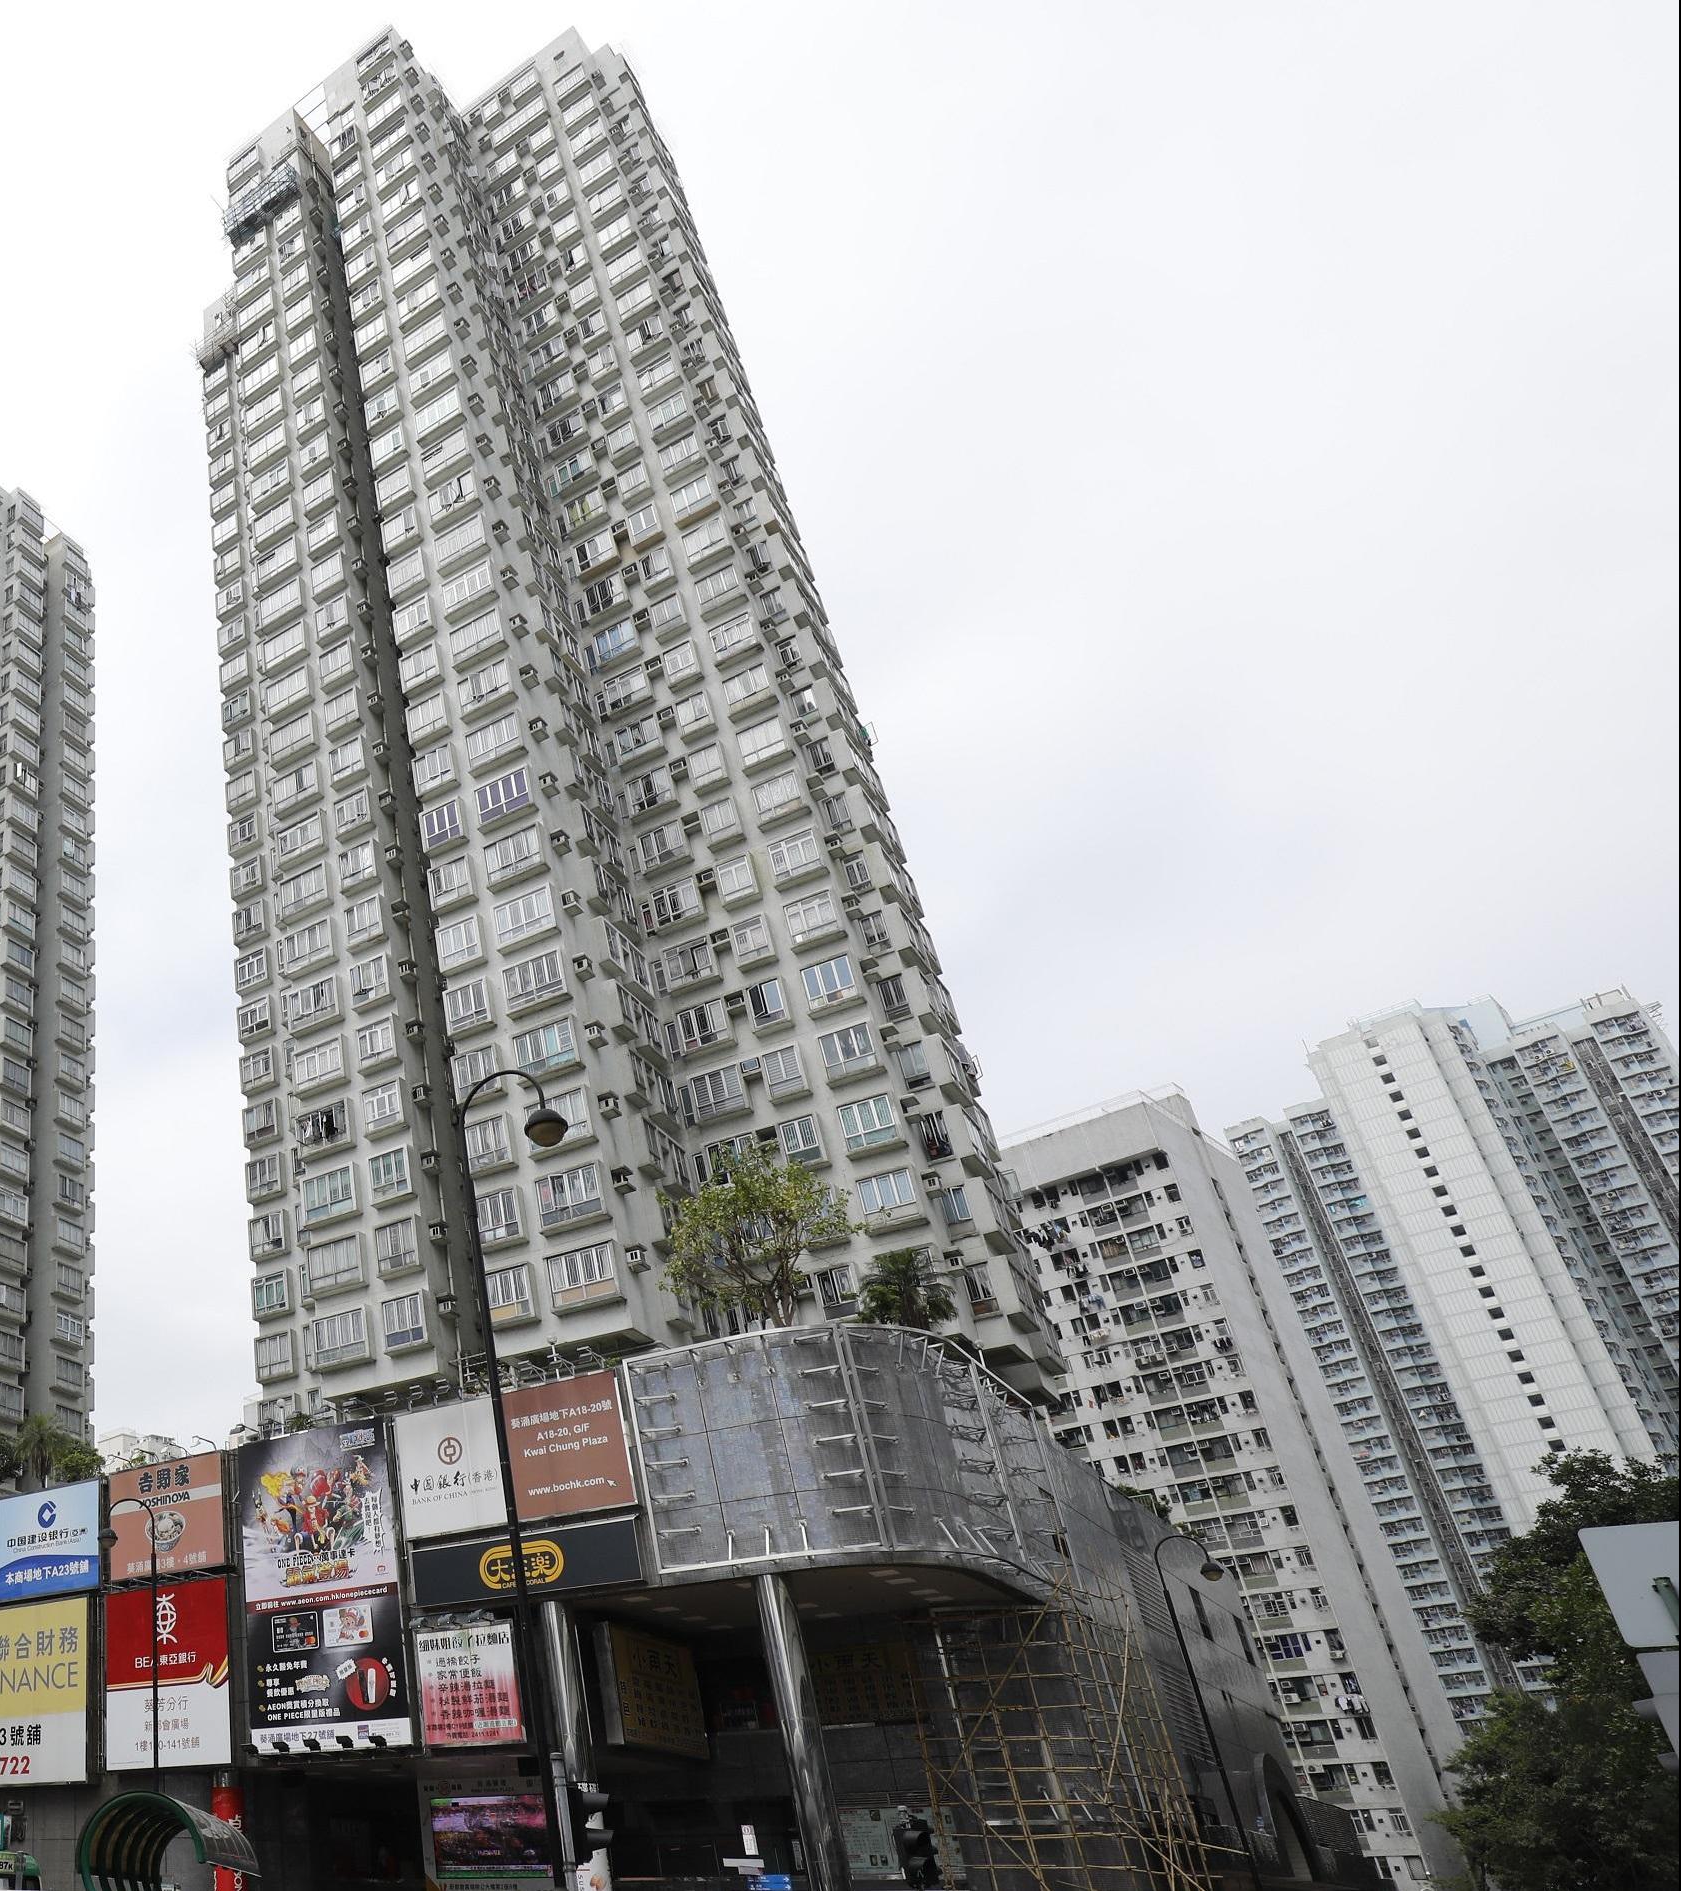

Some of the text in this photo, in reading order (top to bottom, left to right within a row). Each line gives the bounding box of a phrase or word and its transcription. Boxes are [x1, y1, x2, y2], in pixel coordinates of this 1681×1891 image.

[537, 1423, 590, 1441] A18-20, G/F
[524, 1435, 608, 1458] Kwai Chung Plaza
[139, 1464, 190, 1494] 吉野家
[528, 1476, 605, 1497] www.bochk.com
[412, 1497, 431, 1505] BANK
[444, 1491, 468, 1500] CHINA
[278, 1557, 290, 1568] ONE
[160, 1652, 196, 1666] 東亞銀行
[0, 1861, 13, 1870] 87K
